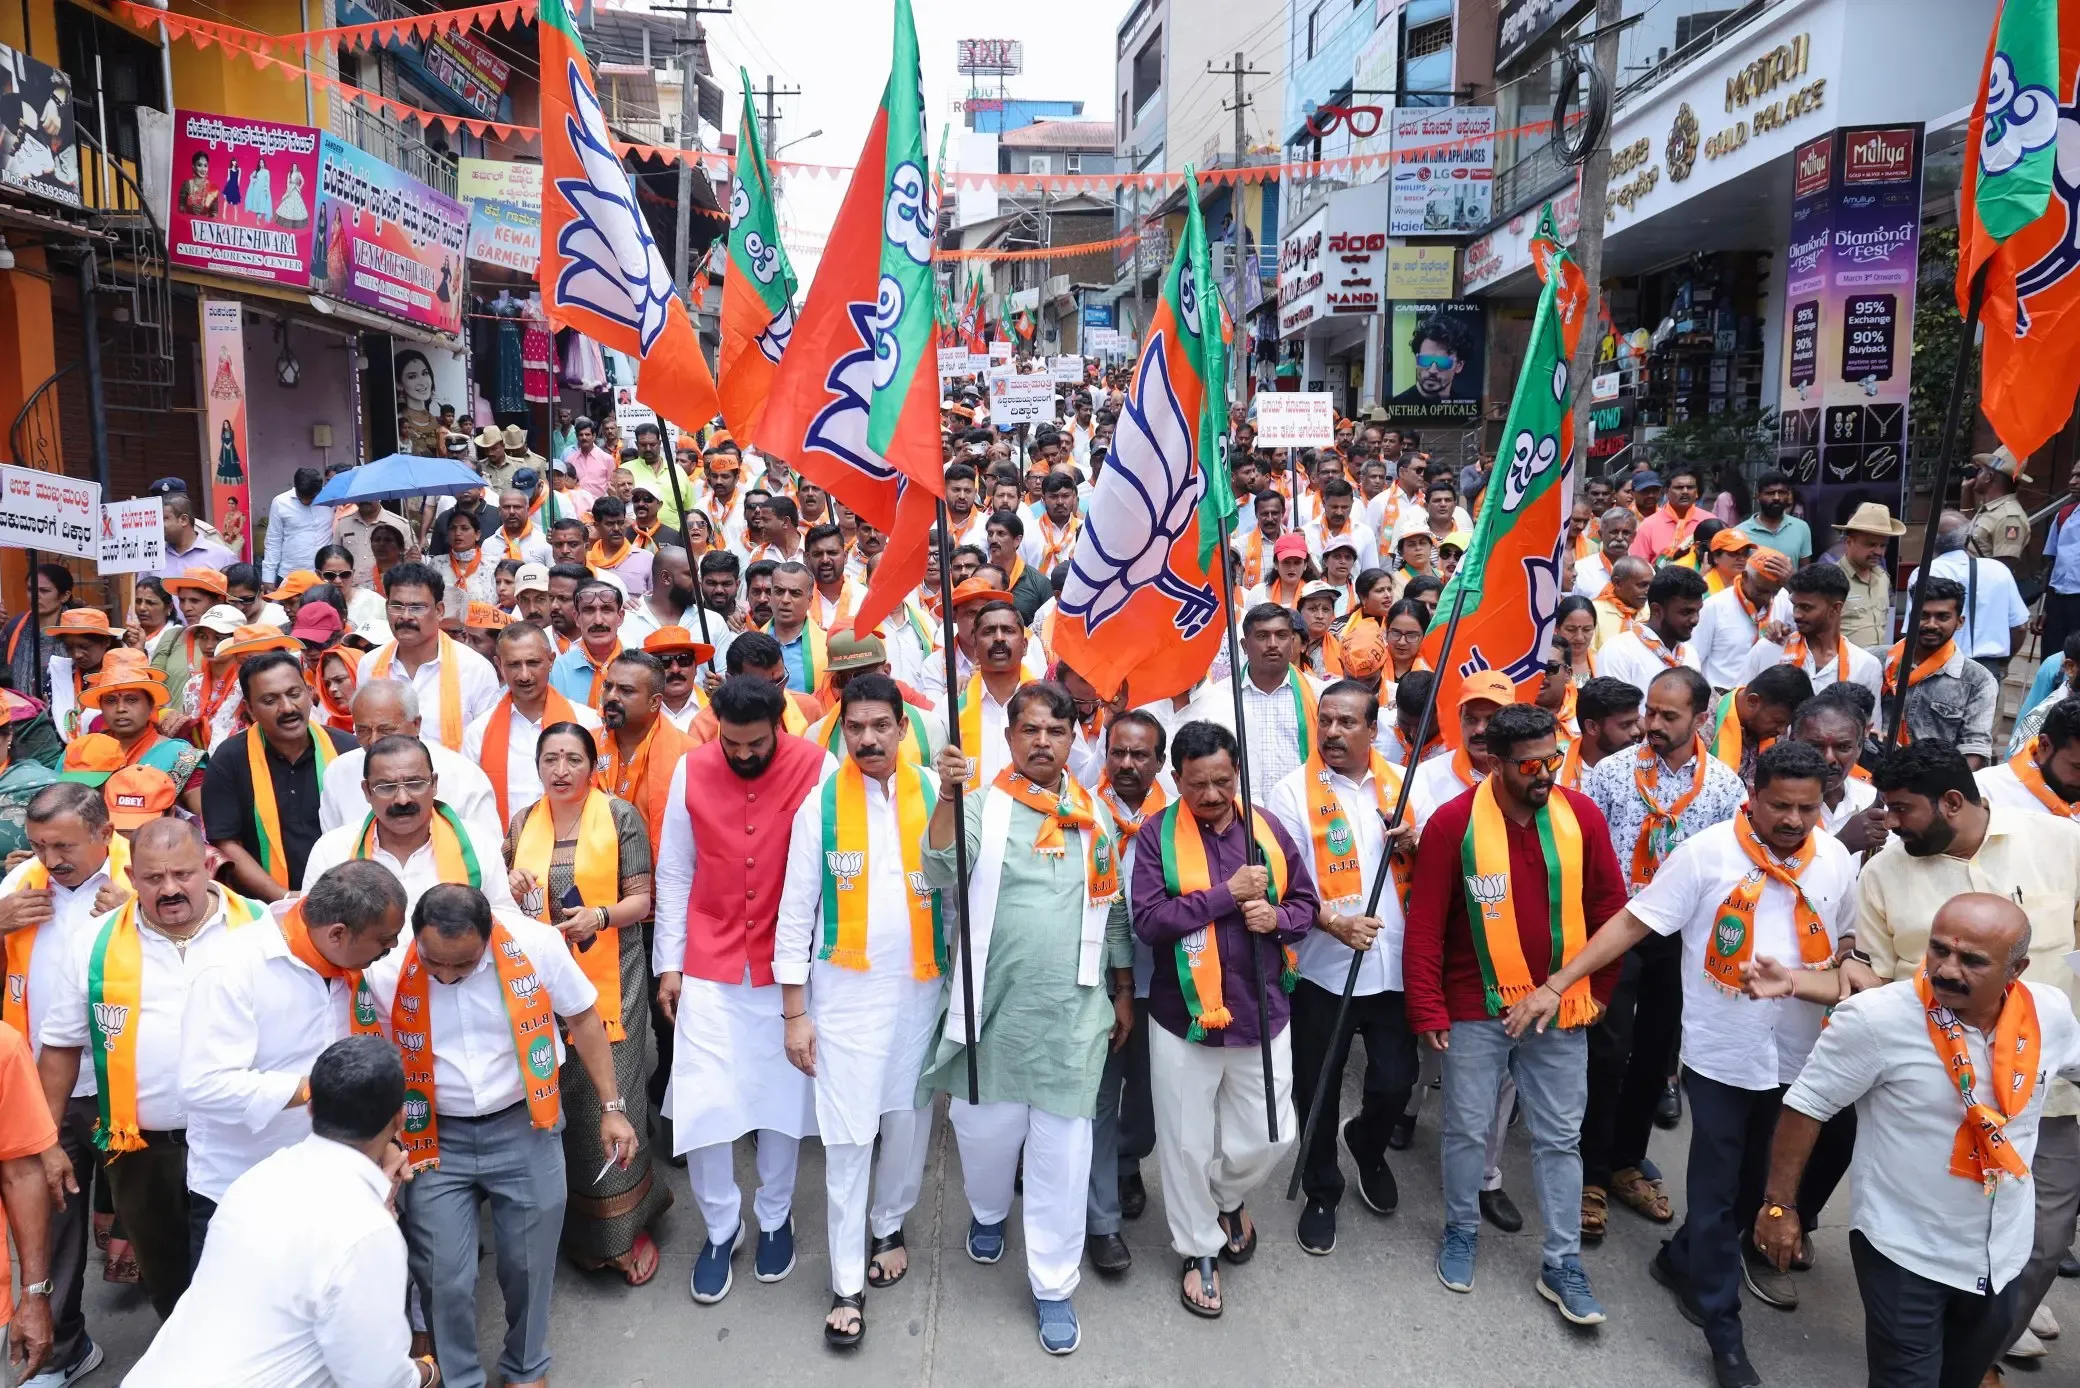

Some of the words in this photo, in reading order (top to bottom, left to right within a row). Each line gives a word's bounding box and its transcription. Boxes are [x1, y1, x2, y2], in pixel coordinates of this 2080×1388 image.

[954, 100, 1003, 112] ROOMS
[1705, 121, 1748, 161] GOLD
[1753, 78, 1827, 136] PALACE
[1448, 149, 1486, 164] APPLIANCES
[1853, 134, 1905, 168] Muliya
[1434, 169, 1449, 179] LG
[28, 178, 79, 206] 6363925909
[1394, 207, 1424, 216] Whirlpool
[1391, 221, 1424, 231] Haier
[191, 220, 297, 255] VENKATESHWARA
[494, 226, 536, 248] KEWAI
[1835, 221, 1915, 246] Diamond
[1328, 231, 1386, 252] ನಂದಿ
[1789, 227, 1830, 258] Diamond
[178, 243, 212, 257] SAREES
[212, 249, 221, 258] &
[222, 250, 263, 265] DRESSES
[264, 257, 302, 271] CENTER
[1842, 243, 1900, 259] Fest
[353, 238, 435, 291] VENKATESHWARA
[1327, 292, 1378, 304] NANDI
[1395, 304, 1437, 312] CARRERA
[1447, 304, 1480, 312] PROWL
[1855, 301, 1885, 314] 95%
[1797, 308, 1813, 322] 95%
[1848, 315, 1891, 325] Exchange
[1794, 322, 1816, 332] Exchange
[1796, 337, 1812, 351] 90%
[1853, 331, 1884, 344] 90%
[1794, 351, 1813, 361] Buyback
[1849, 345, 1887, 355] Buyback
[1388, 405, 1427, 416] NETHRA
[1430, 404, 1478, 416] OPTICALS
[36, 482, 89, 514] ಮುಖ್ಯಮಂತ್ರಿ
[1329, 859, 1359, 874] B.J.P.
[1723, 895, 1755, 912] B.J.P.
[1708, 956, 1734, 976] B.J.P.
[406, 1072, 433, 1083] .J.P.
